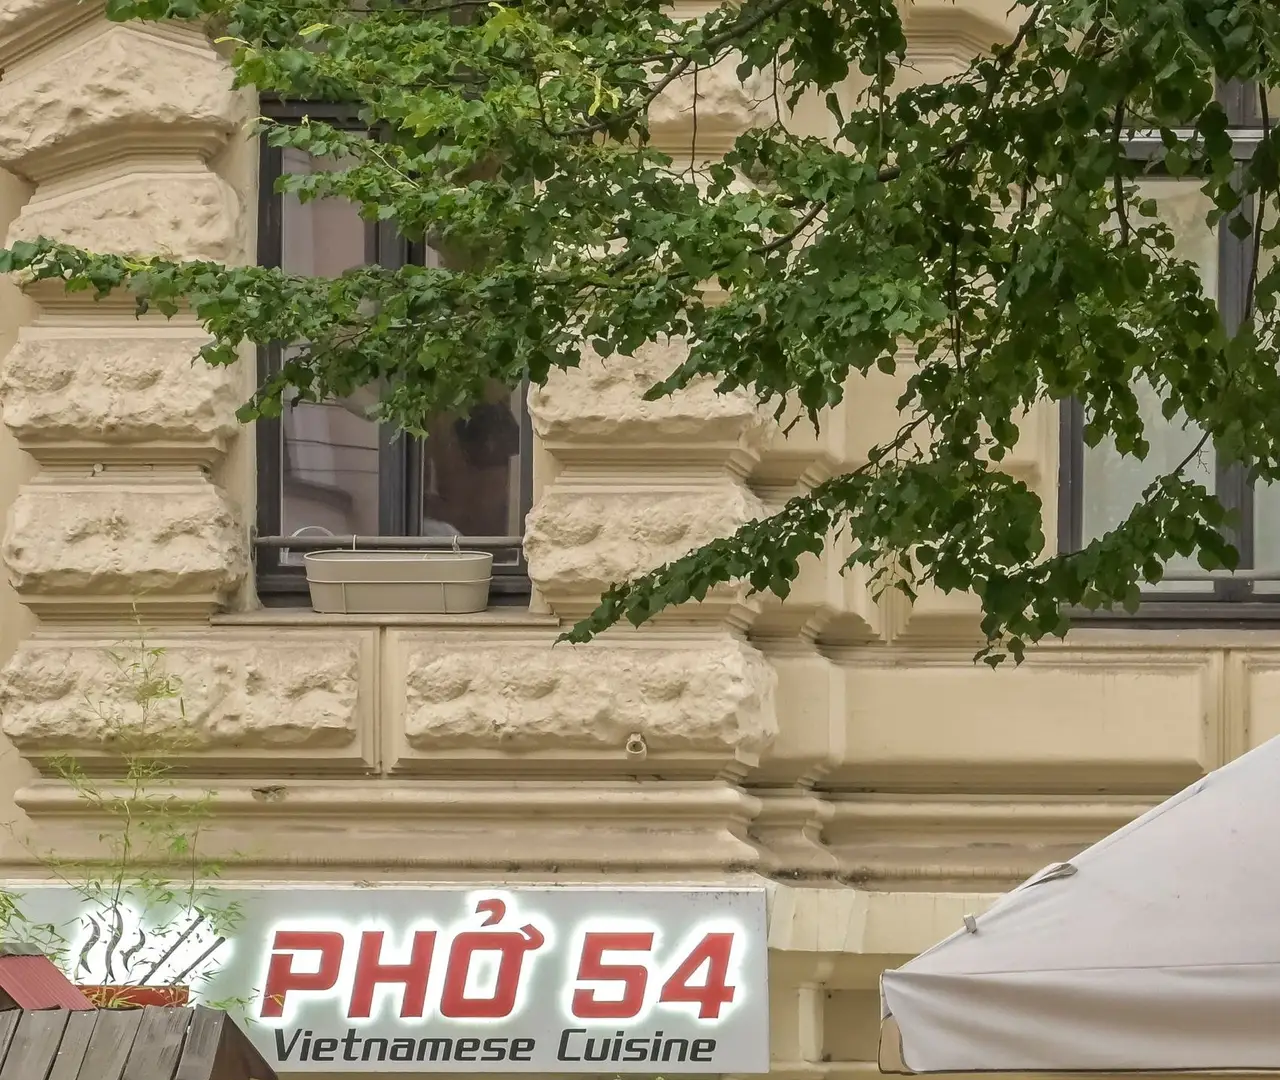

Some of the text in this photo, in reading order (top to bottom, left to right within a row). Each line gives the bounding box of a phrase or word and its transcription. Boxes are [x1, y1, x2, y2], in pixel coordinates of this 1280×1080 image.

[259, 897, 737, 1018] PHỞ 54
[273, 1027, 718, 1063] Vietnamese Cuisine
